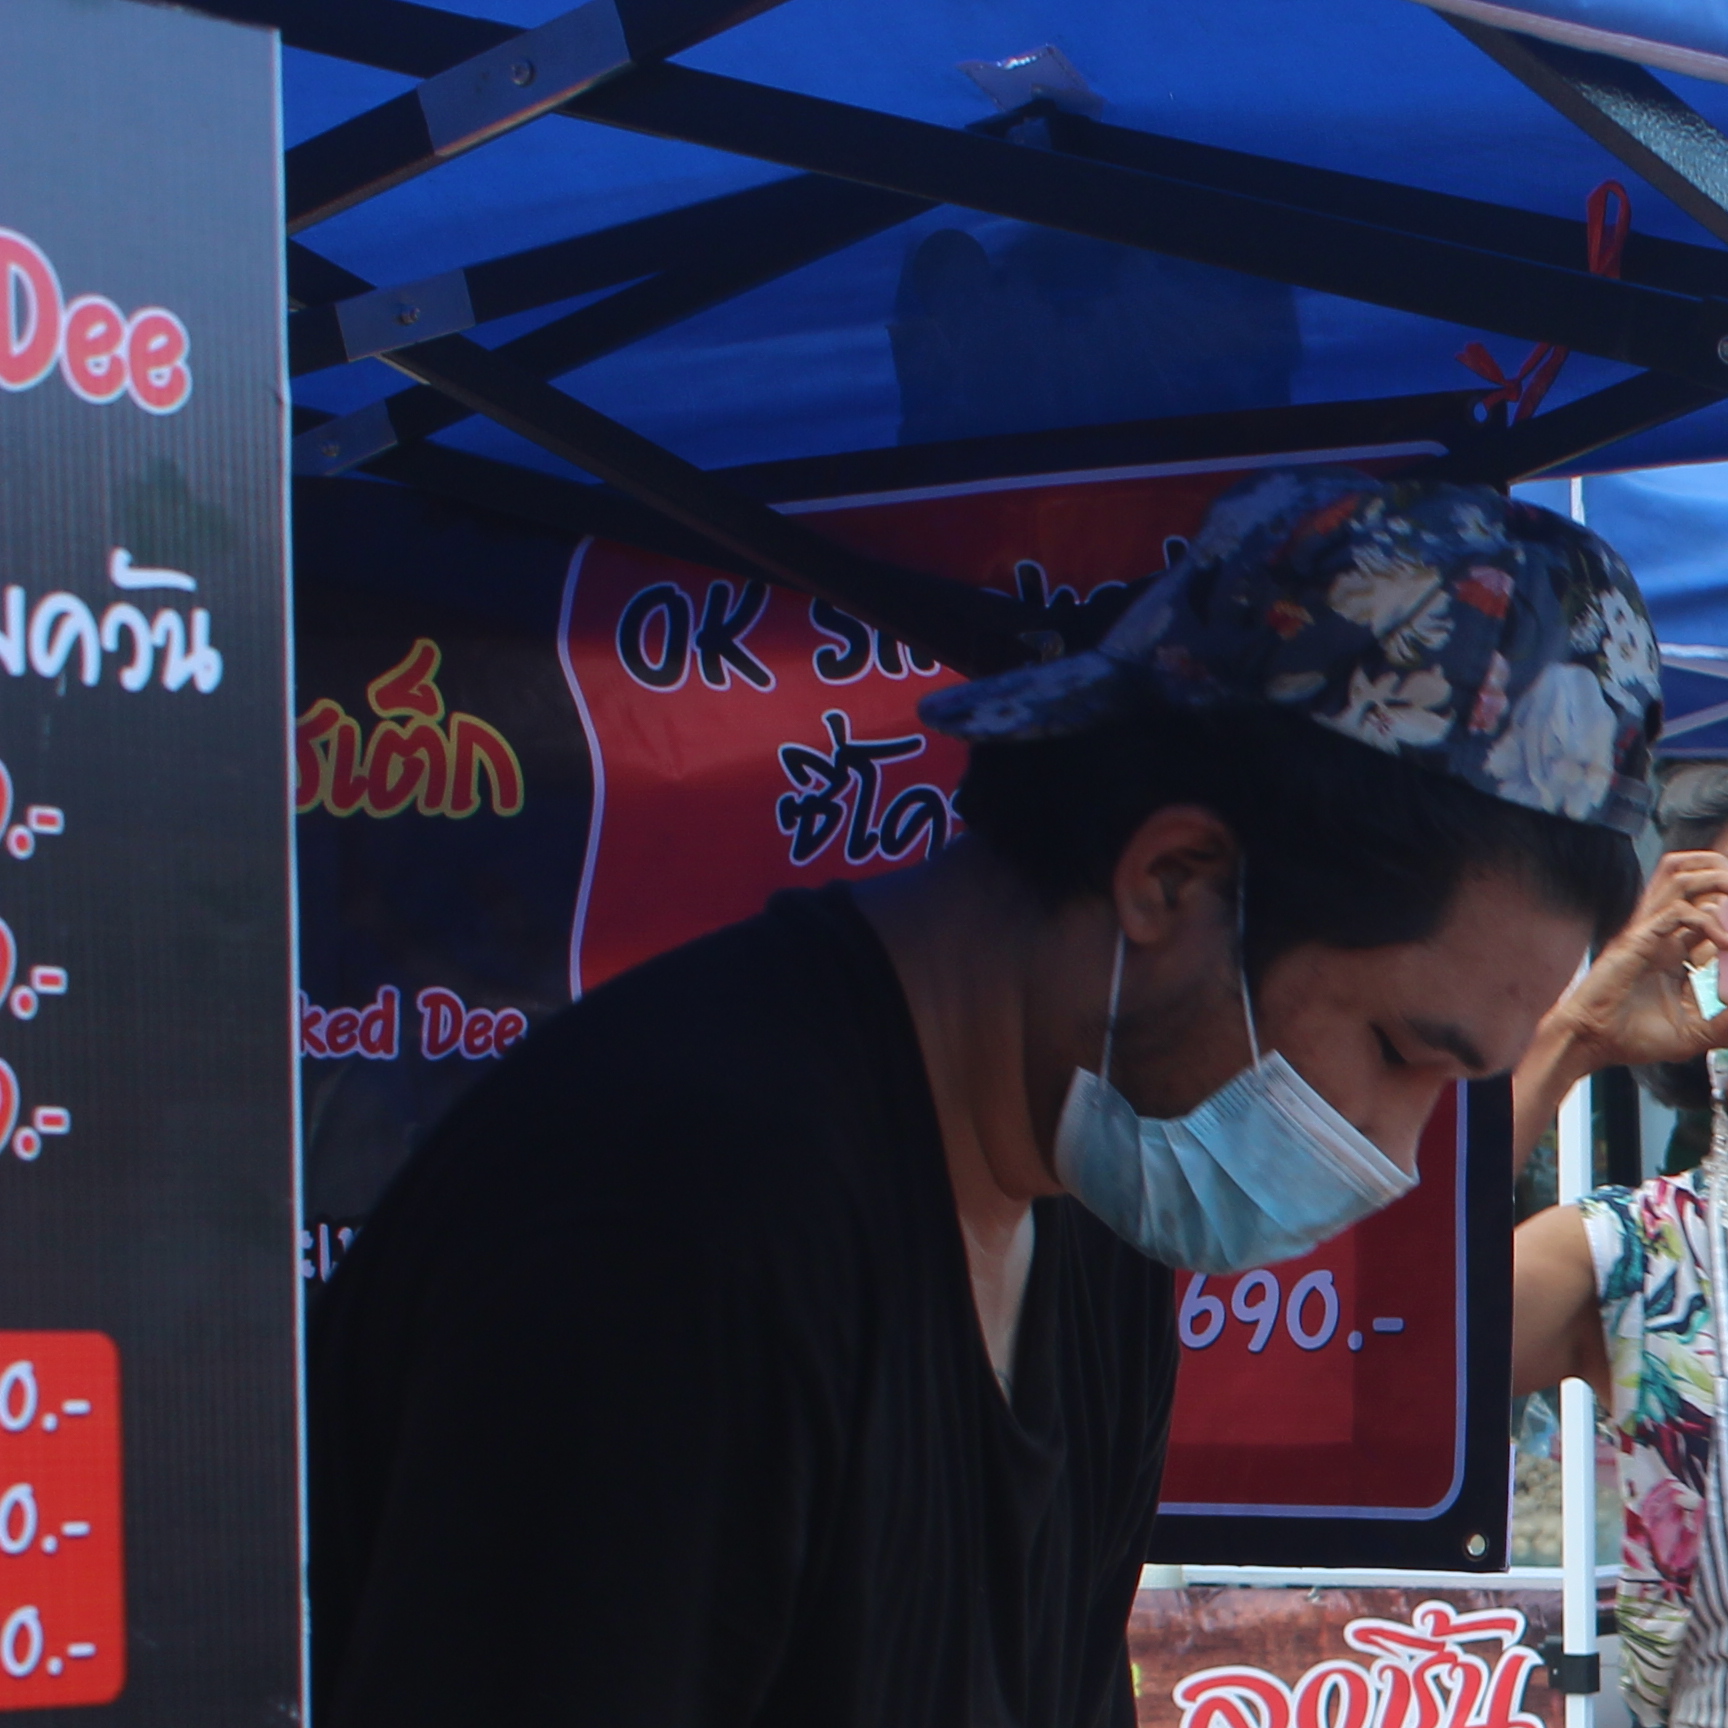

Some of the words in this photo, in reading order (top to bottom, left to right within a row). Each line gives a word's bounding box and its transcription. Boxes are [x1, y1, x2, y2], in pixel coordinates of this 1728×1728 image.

[0, 226, 192, 415] Dee
[615, 579, 776, 692] OK
[417, 985, 528, 1060] Dee
